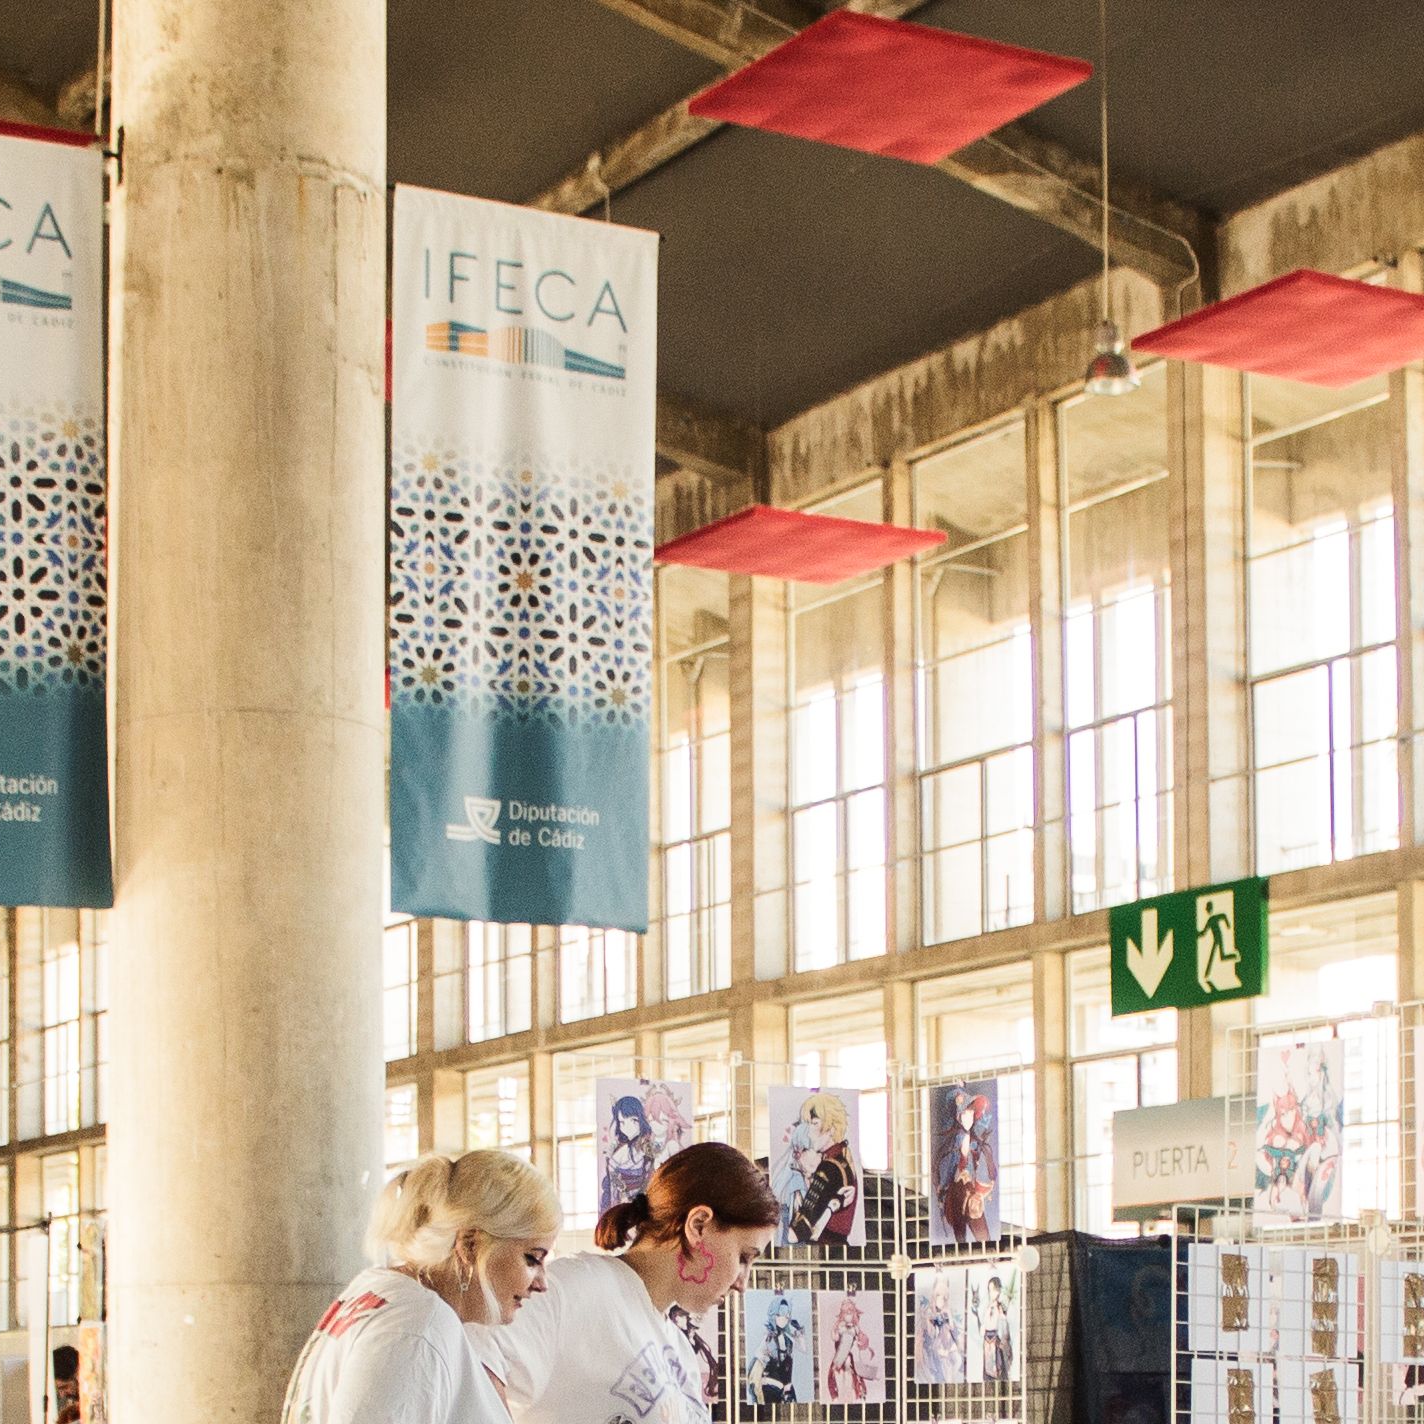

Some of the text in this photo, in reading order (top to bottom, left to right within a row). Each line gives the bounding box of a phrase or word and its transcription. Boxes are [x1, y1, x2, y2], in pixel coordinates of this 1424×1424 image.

[424, 248, 628, 334] IFECA
[508, 801, 600, 826] Diputación
[508, 827, 585, 850] de Cádiz
[1132, 1140, 1238, 1180] PUERTA 2
